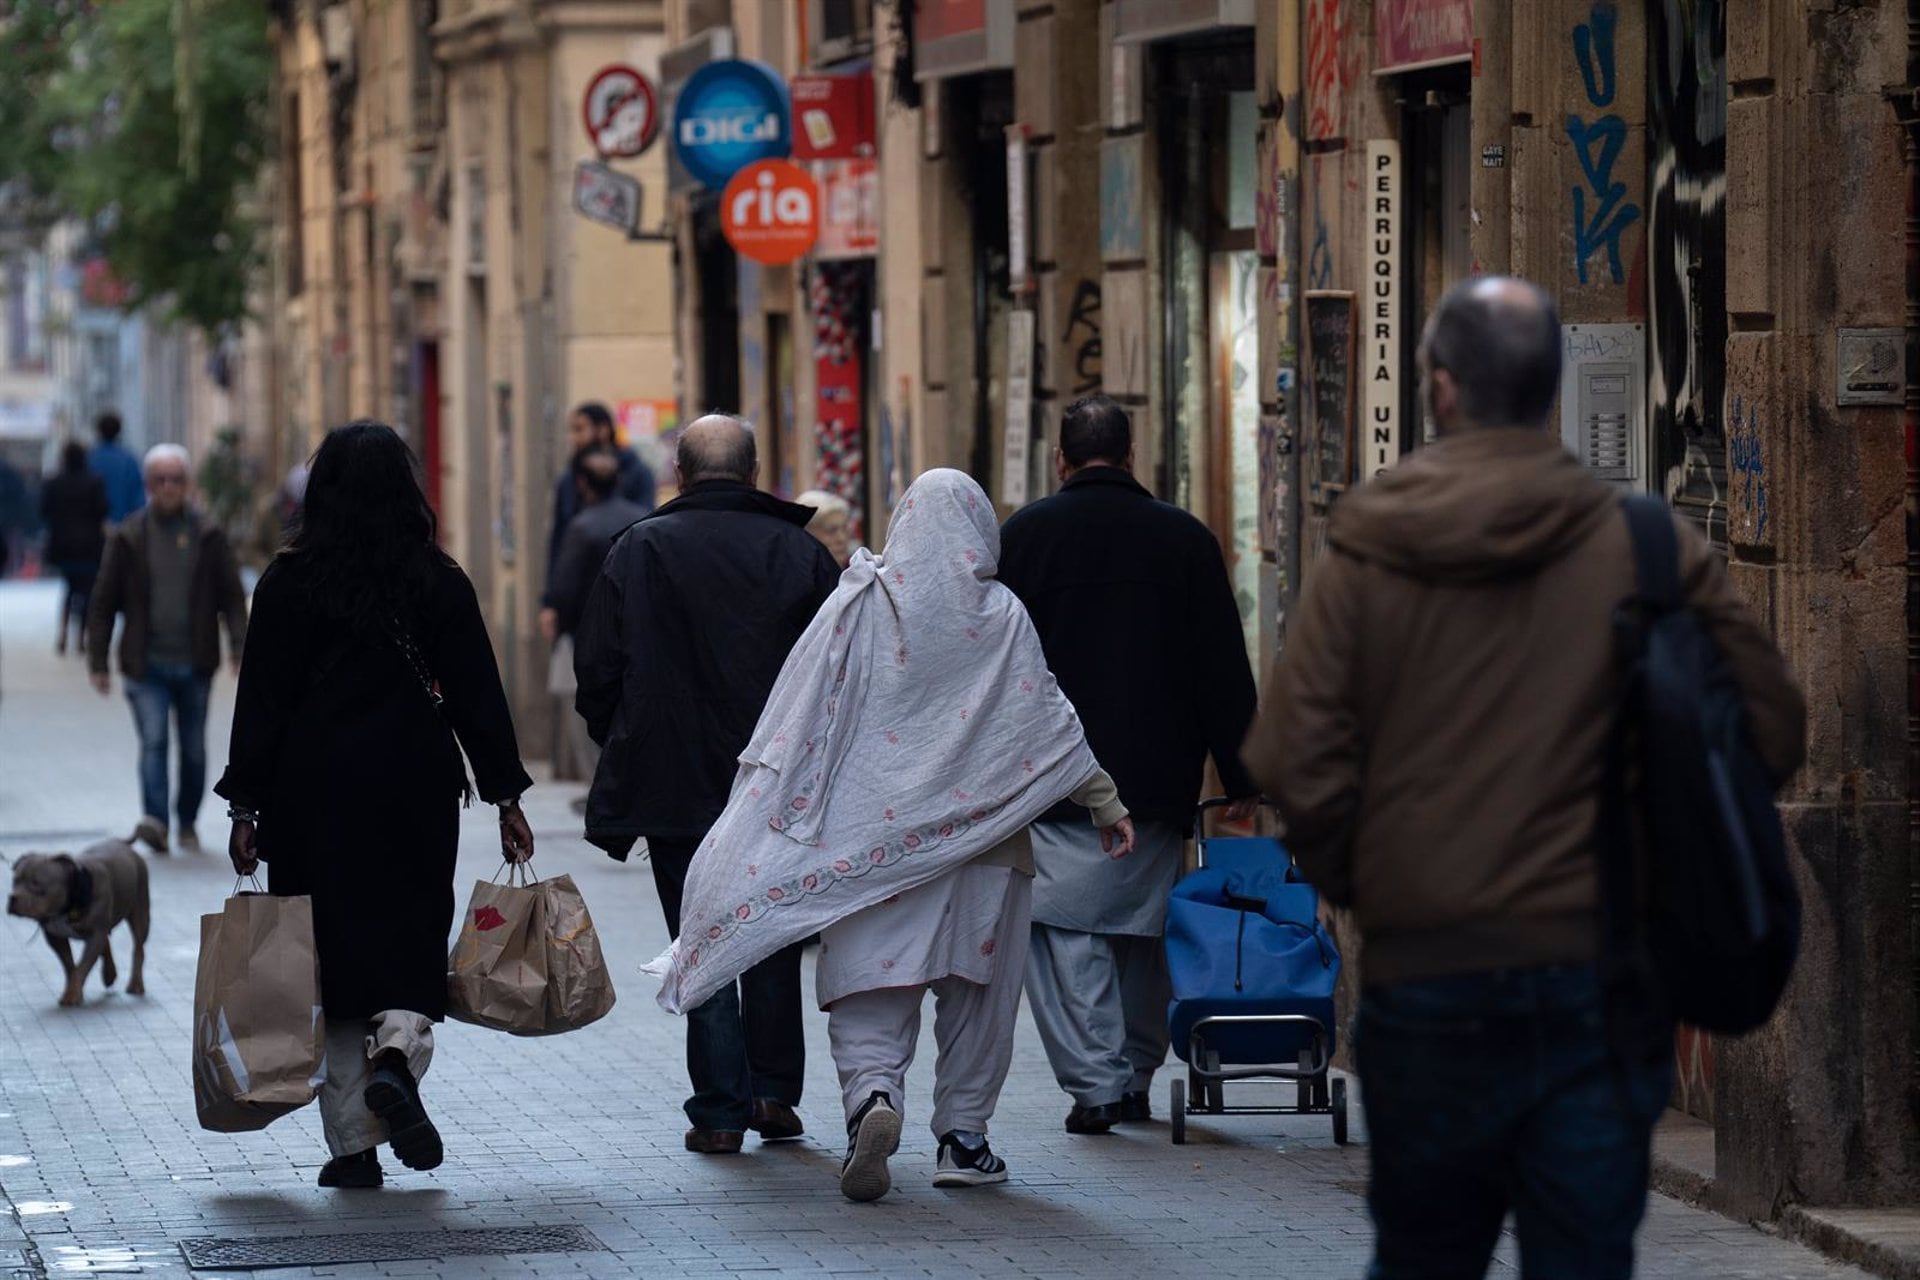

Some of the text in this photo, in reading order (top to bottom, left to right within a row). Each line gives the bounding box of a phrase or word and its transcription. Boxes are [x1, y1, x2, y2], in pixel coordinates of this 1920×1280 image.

[680, 112, 779, 146] DIGI
[732, 170, 812, 226] ria
[1374, 155, 1391, 381] PERRUQUERIA
